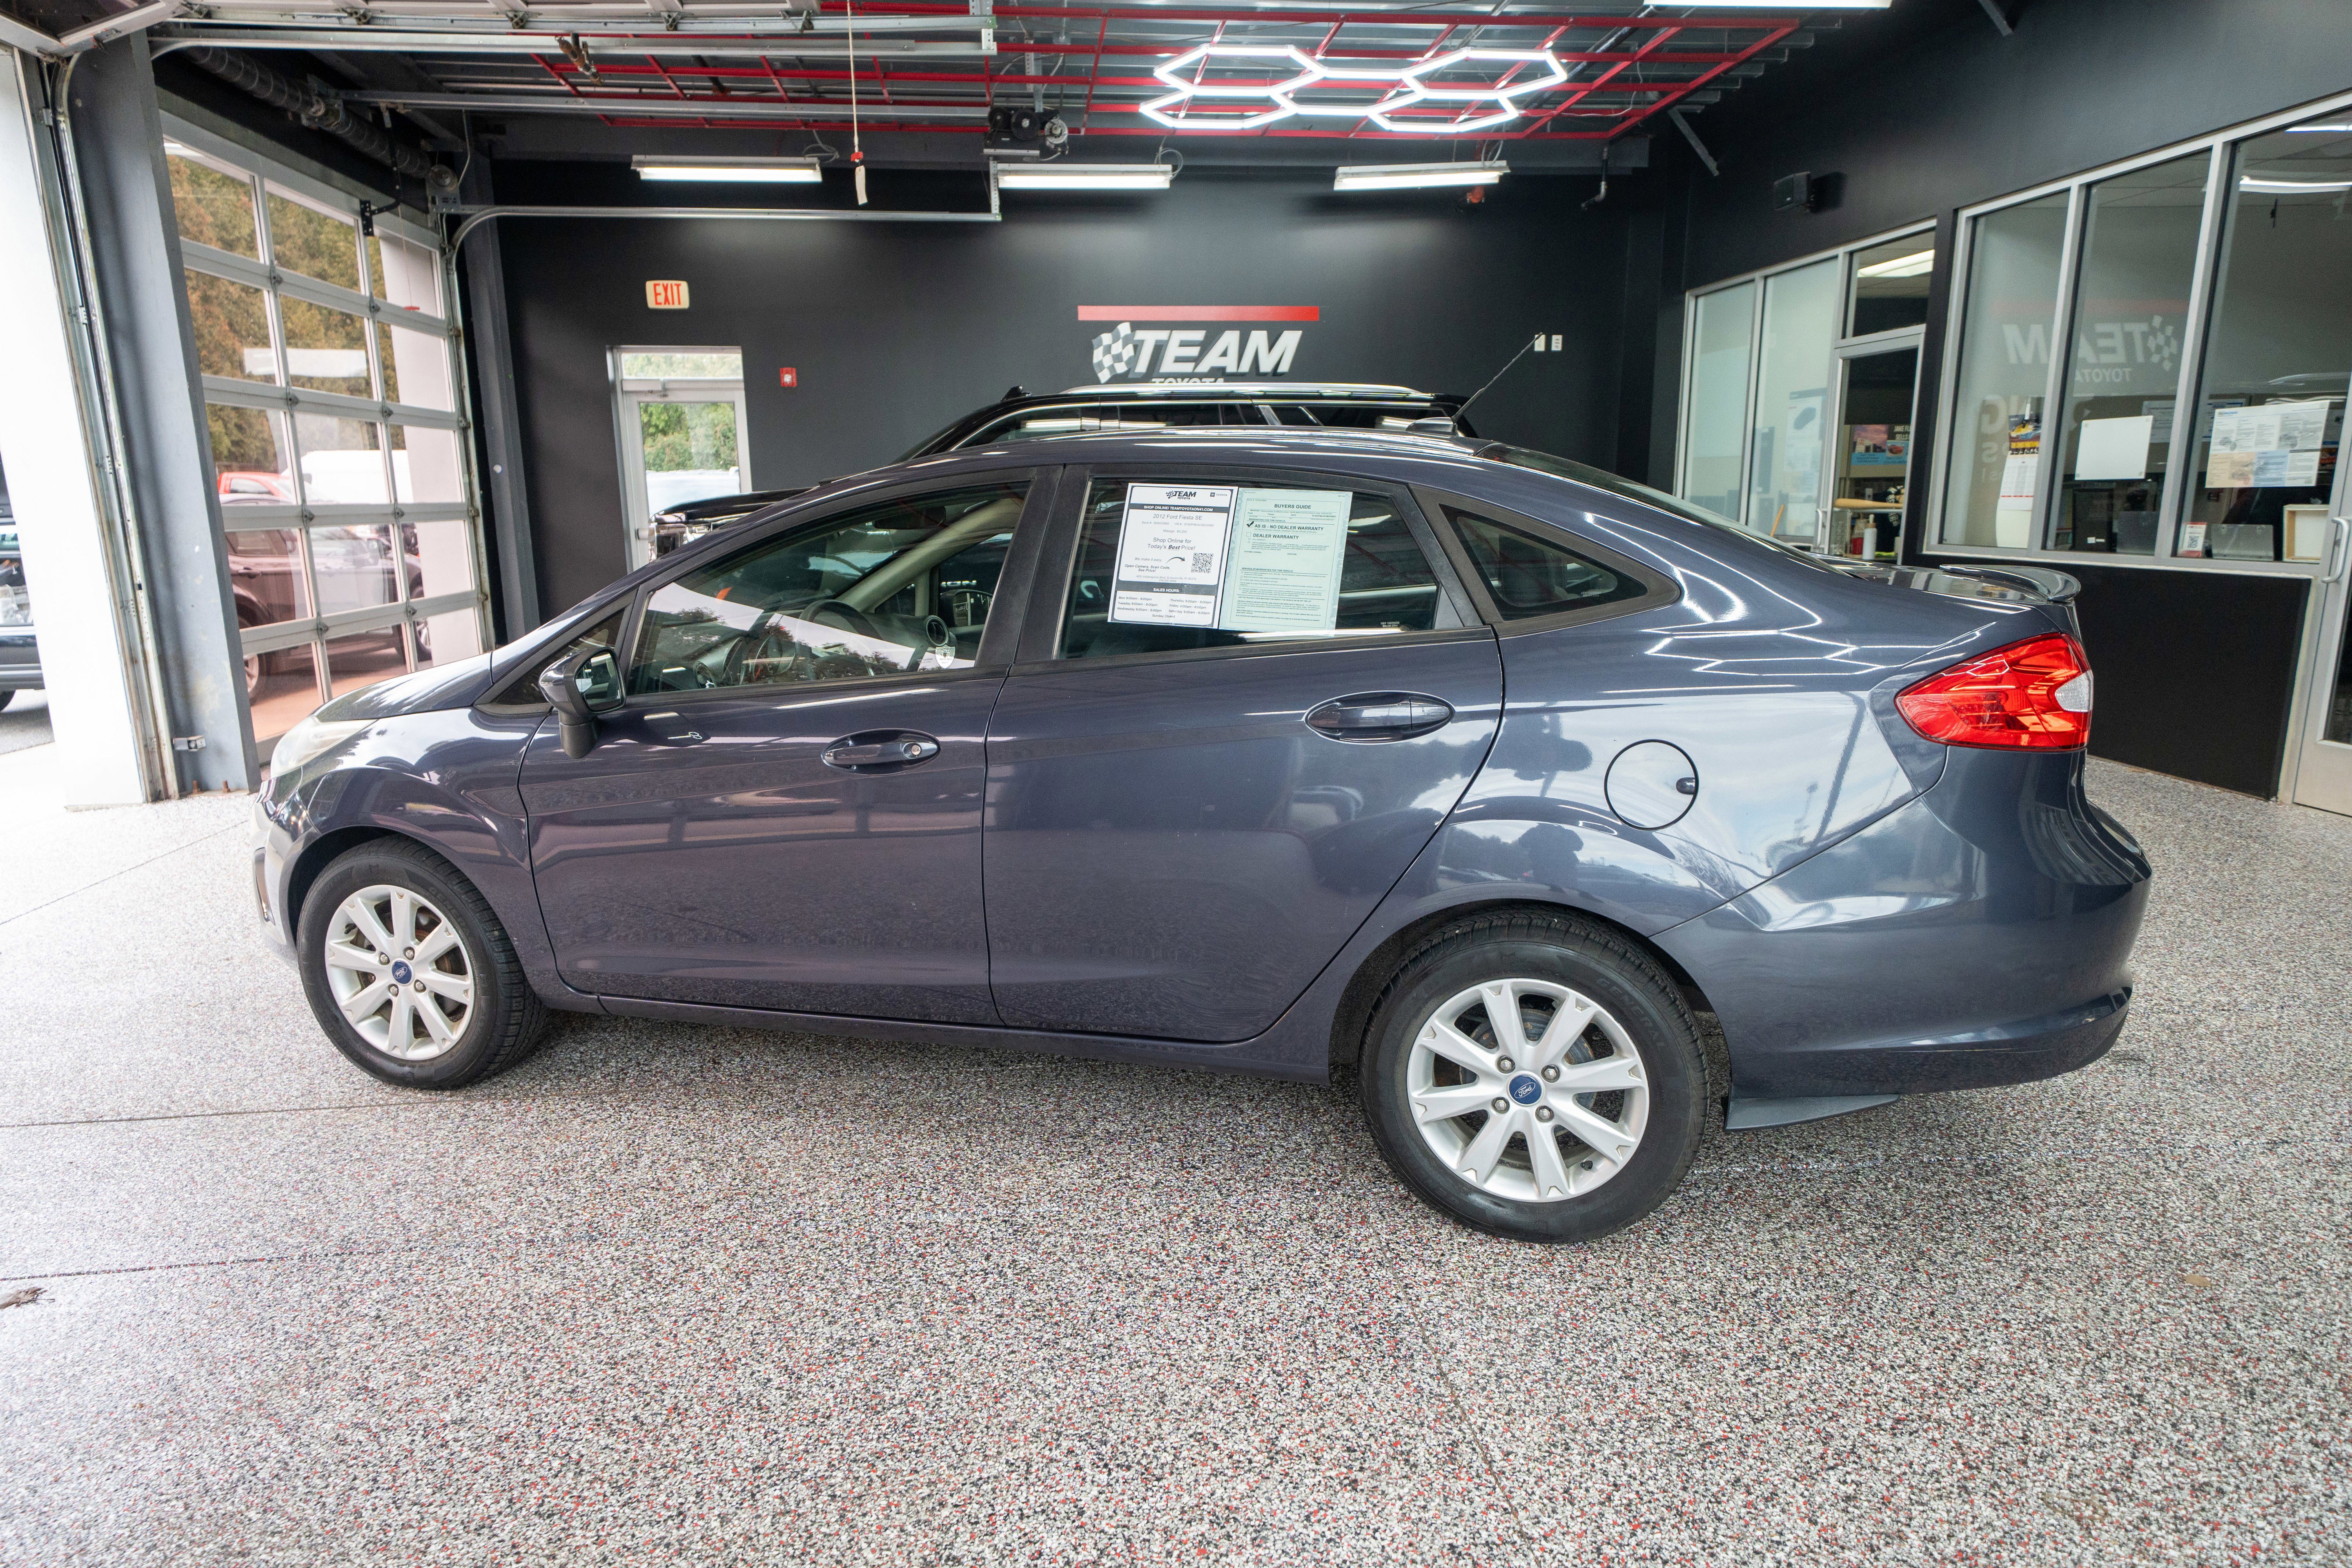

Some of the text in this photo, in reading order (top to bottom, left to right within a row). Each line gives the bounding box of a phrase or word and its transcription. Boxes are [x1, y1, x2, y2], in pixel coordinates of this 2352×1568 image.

[653, 283, 682, 305] EXIT
[1131, 330, 1303, 375] TEAM
[1597, 978, 1666, 1052] GENERAL
[1518, 1084, 1532, 1097] Ford
